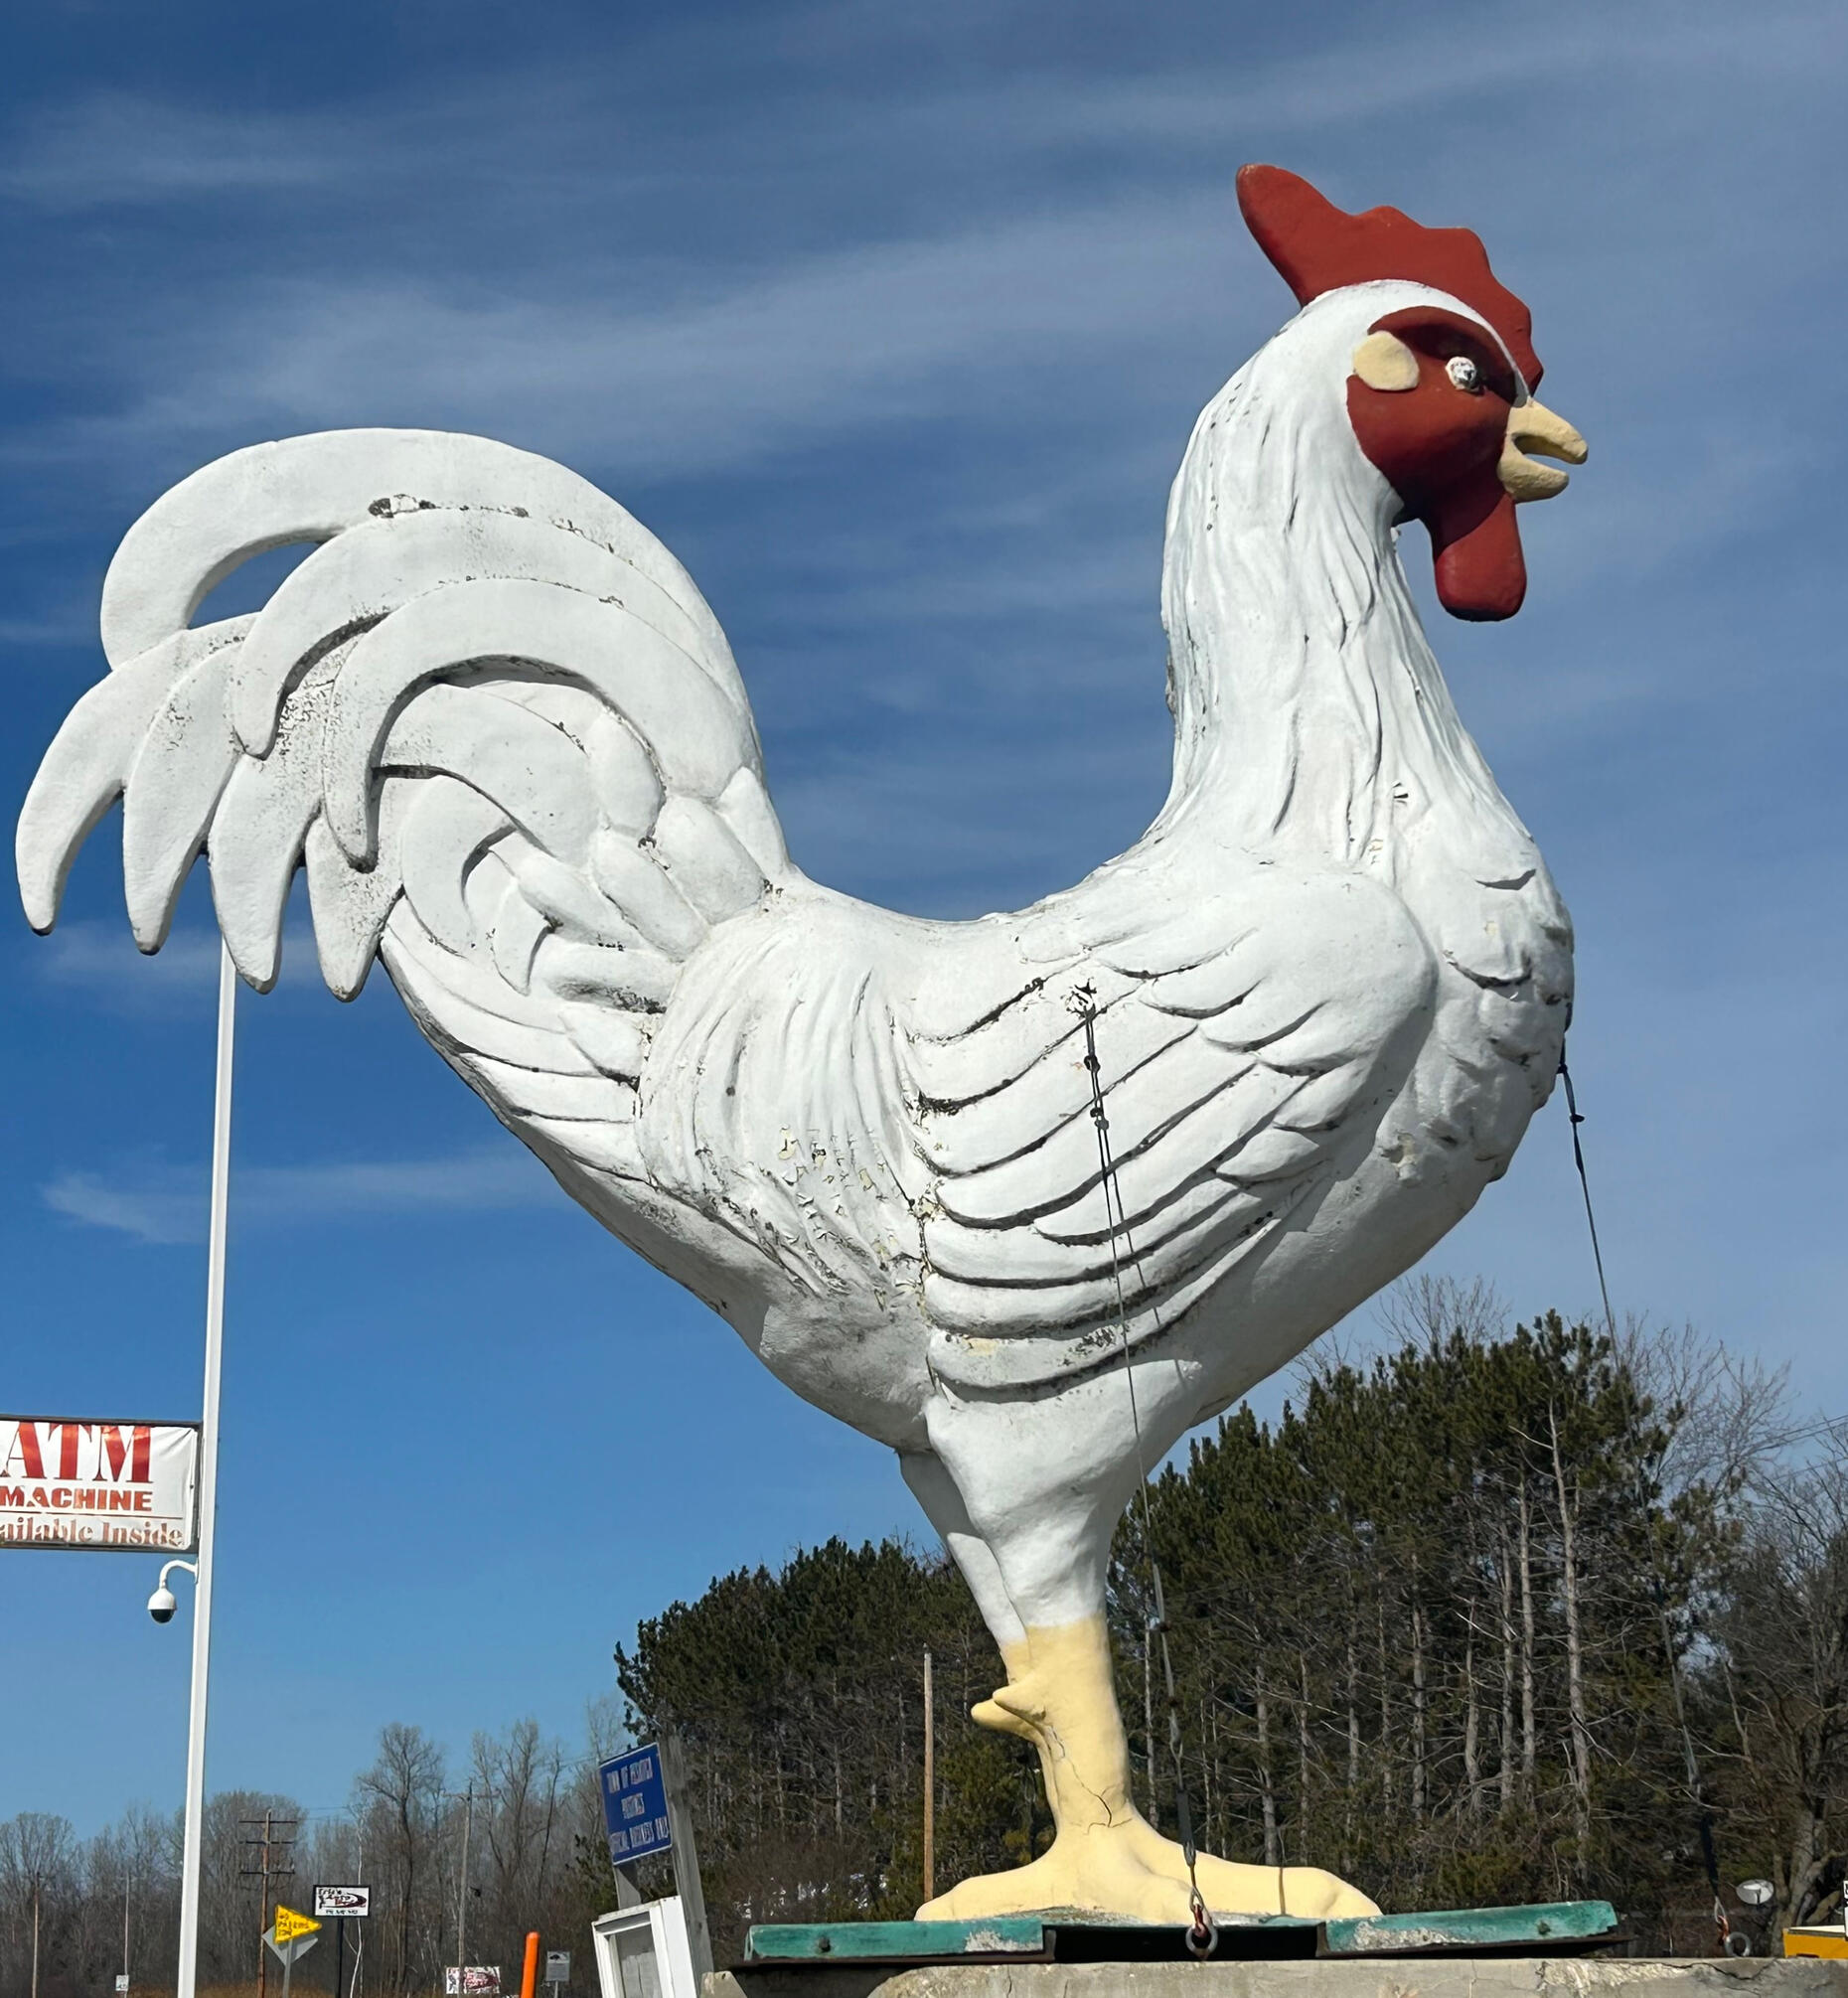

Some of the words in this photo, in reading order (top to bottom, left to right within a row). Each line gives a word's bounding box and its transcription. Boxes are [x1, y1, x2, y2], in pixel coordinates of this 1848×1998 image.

[0, 1421, 153, 1483] ATM
[0, 1485, 153, 1511] MACHINE
[102, 1521, 184, 1548] Inside
